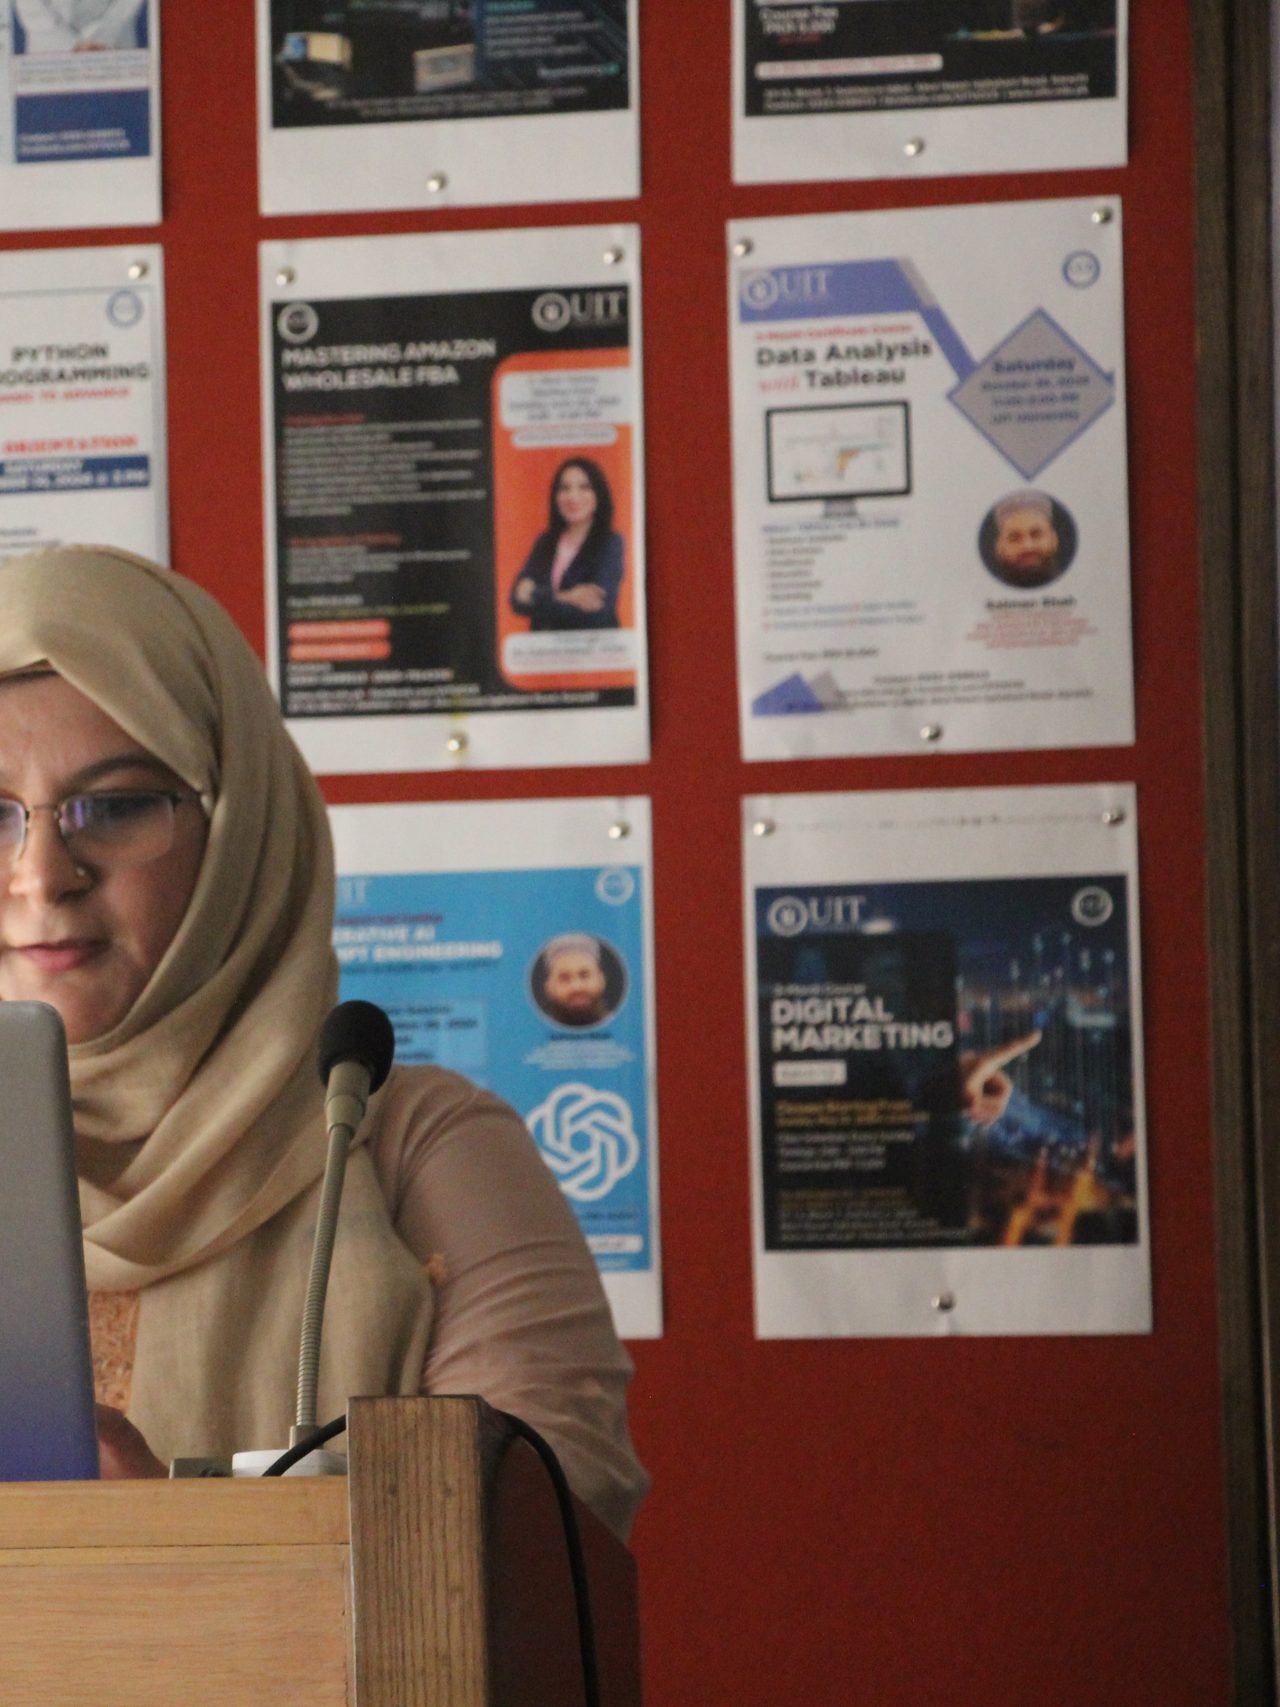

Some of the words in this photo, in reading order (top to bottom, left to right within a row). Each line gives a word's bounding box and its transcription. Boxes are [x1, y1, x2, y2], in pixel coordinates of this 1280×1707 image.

[781, 270, 834, 297] UIT
[572, 292, 625, 321] UIT
[11, 343, 109, 364] PYTHON
[282, 343, 401, 368] MASTERING
[404, 338, 497, 361] AMAZON
[757, 346, 817, 366] Data
[825, 337, 932, 364] Analysis
[993, 356, 1076, 374] Saturday
[283, 367, 414, 392] WHOLESALE
[417, 364, 460, 387] FBA
[804, 366, 907, 389] Tableau
[2, 434, 138, 455] ORIENTATION
[810, 895, 867, 923] UIT
[414, 924, 436, 940] AI
[373, 939, 504, 962] ENGINEERING
[772, 996, 893, 1025] DIGITAL
[773, 1020, 954, 1052] MARKETING
